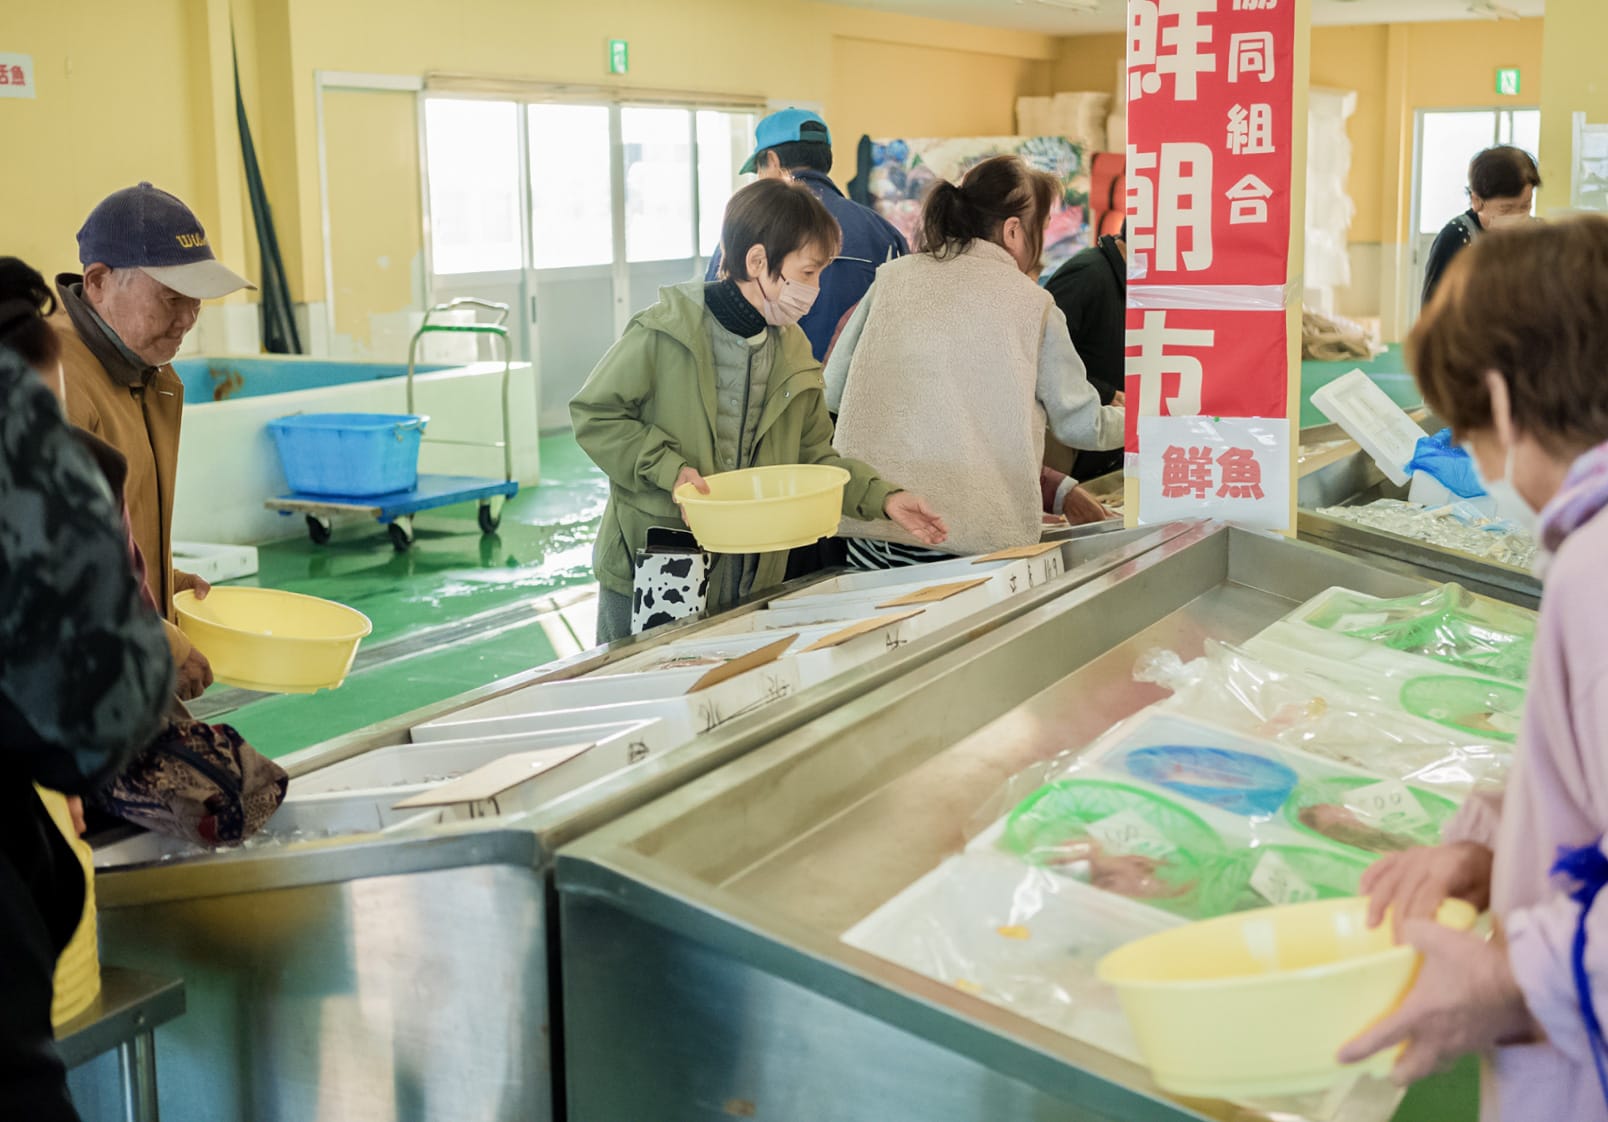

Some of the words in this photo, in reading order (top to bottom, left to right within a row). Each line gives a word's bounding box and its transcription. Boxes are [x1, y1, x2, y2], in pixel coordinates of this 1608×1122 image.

[1225, 0, 1278, 225] 同組合
[1162, 445, 1264, 500] 鮮魚
